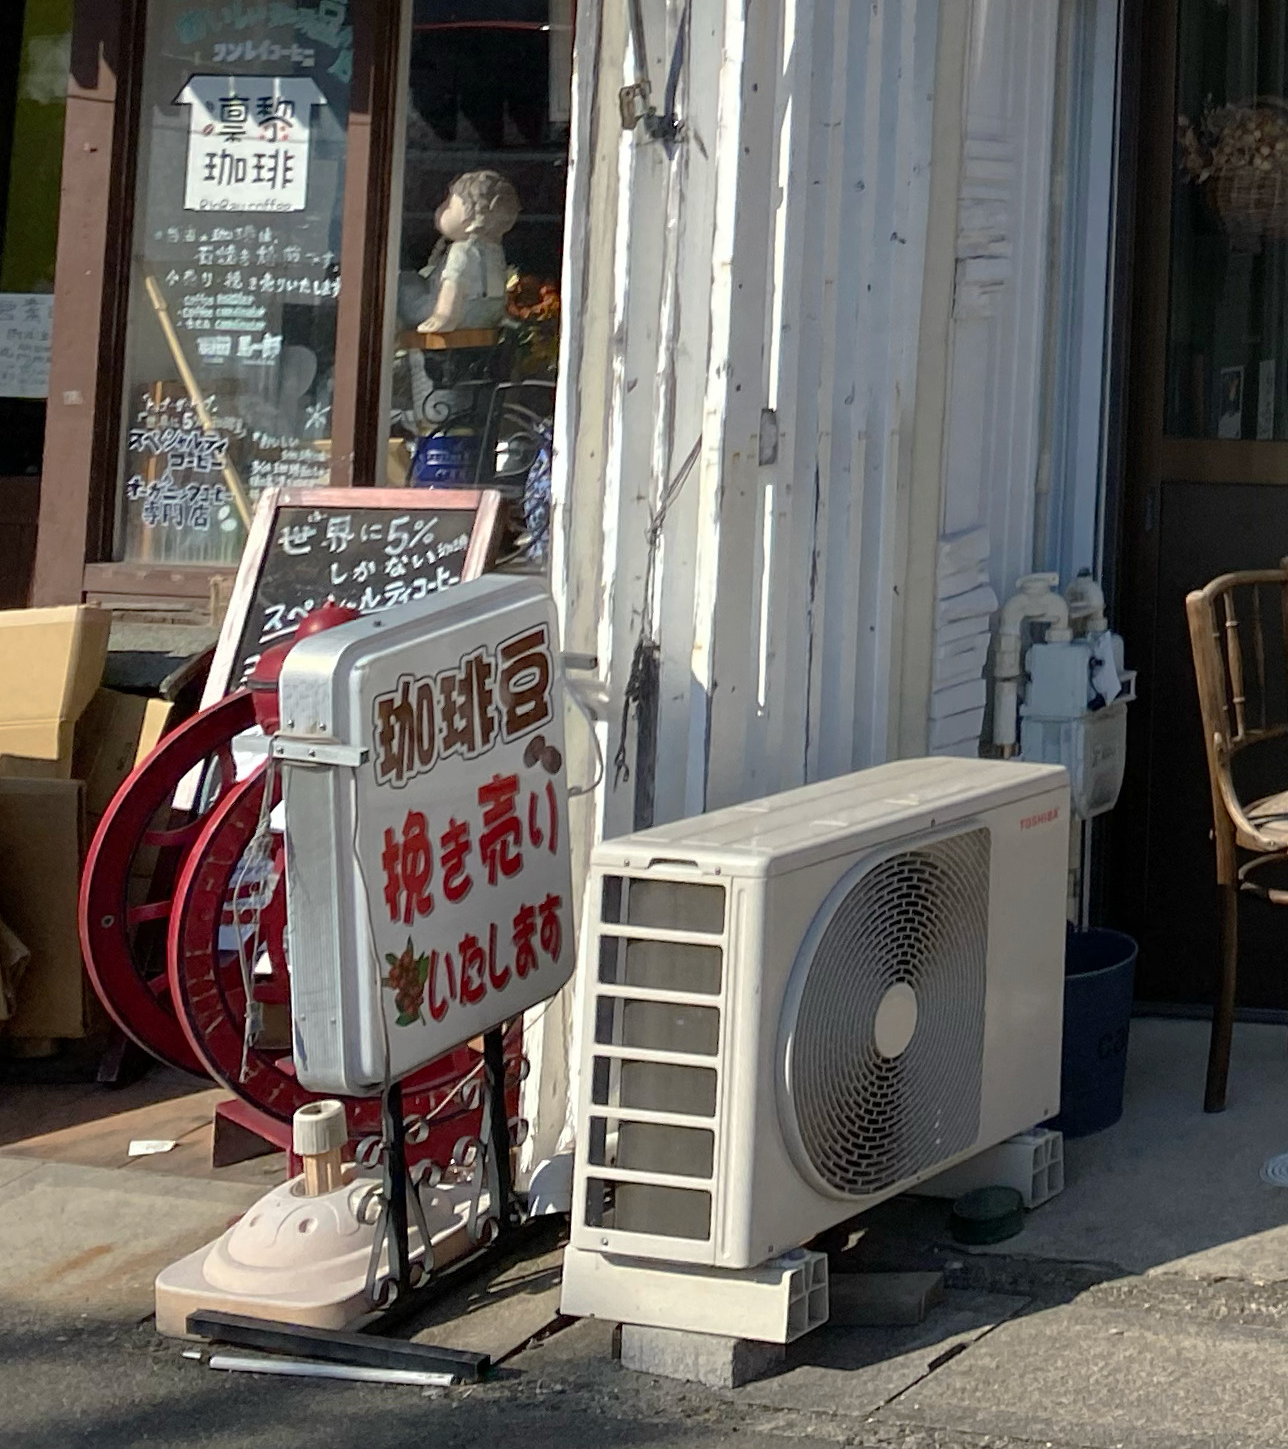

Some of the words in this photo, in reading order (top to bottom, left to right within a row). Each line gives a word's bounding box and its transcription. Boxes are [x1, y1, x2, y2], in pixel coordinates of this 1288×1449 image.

[203, 148, 296, 190] 珈琲
[375, 625, 553, 787] 珈琲豆
[381, 772, 559, 926] 挽き売り
[1019, 809, 1060, 831] TOSHIBA
[427, 892, 563, 1023] いたします
